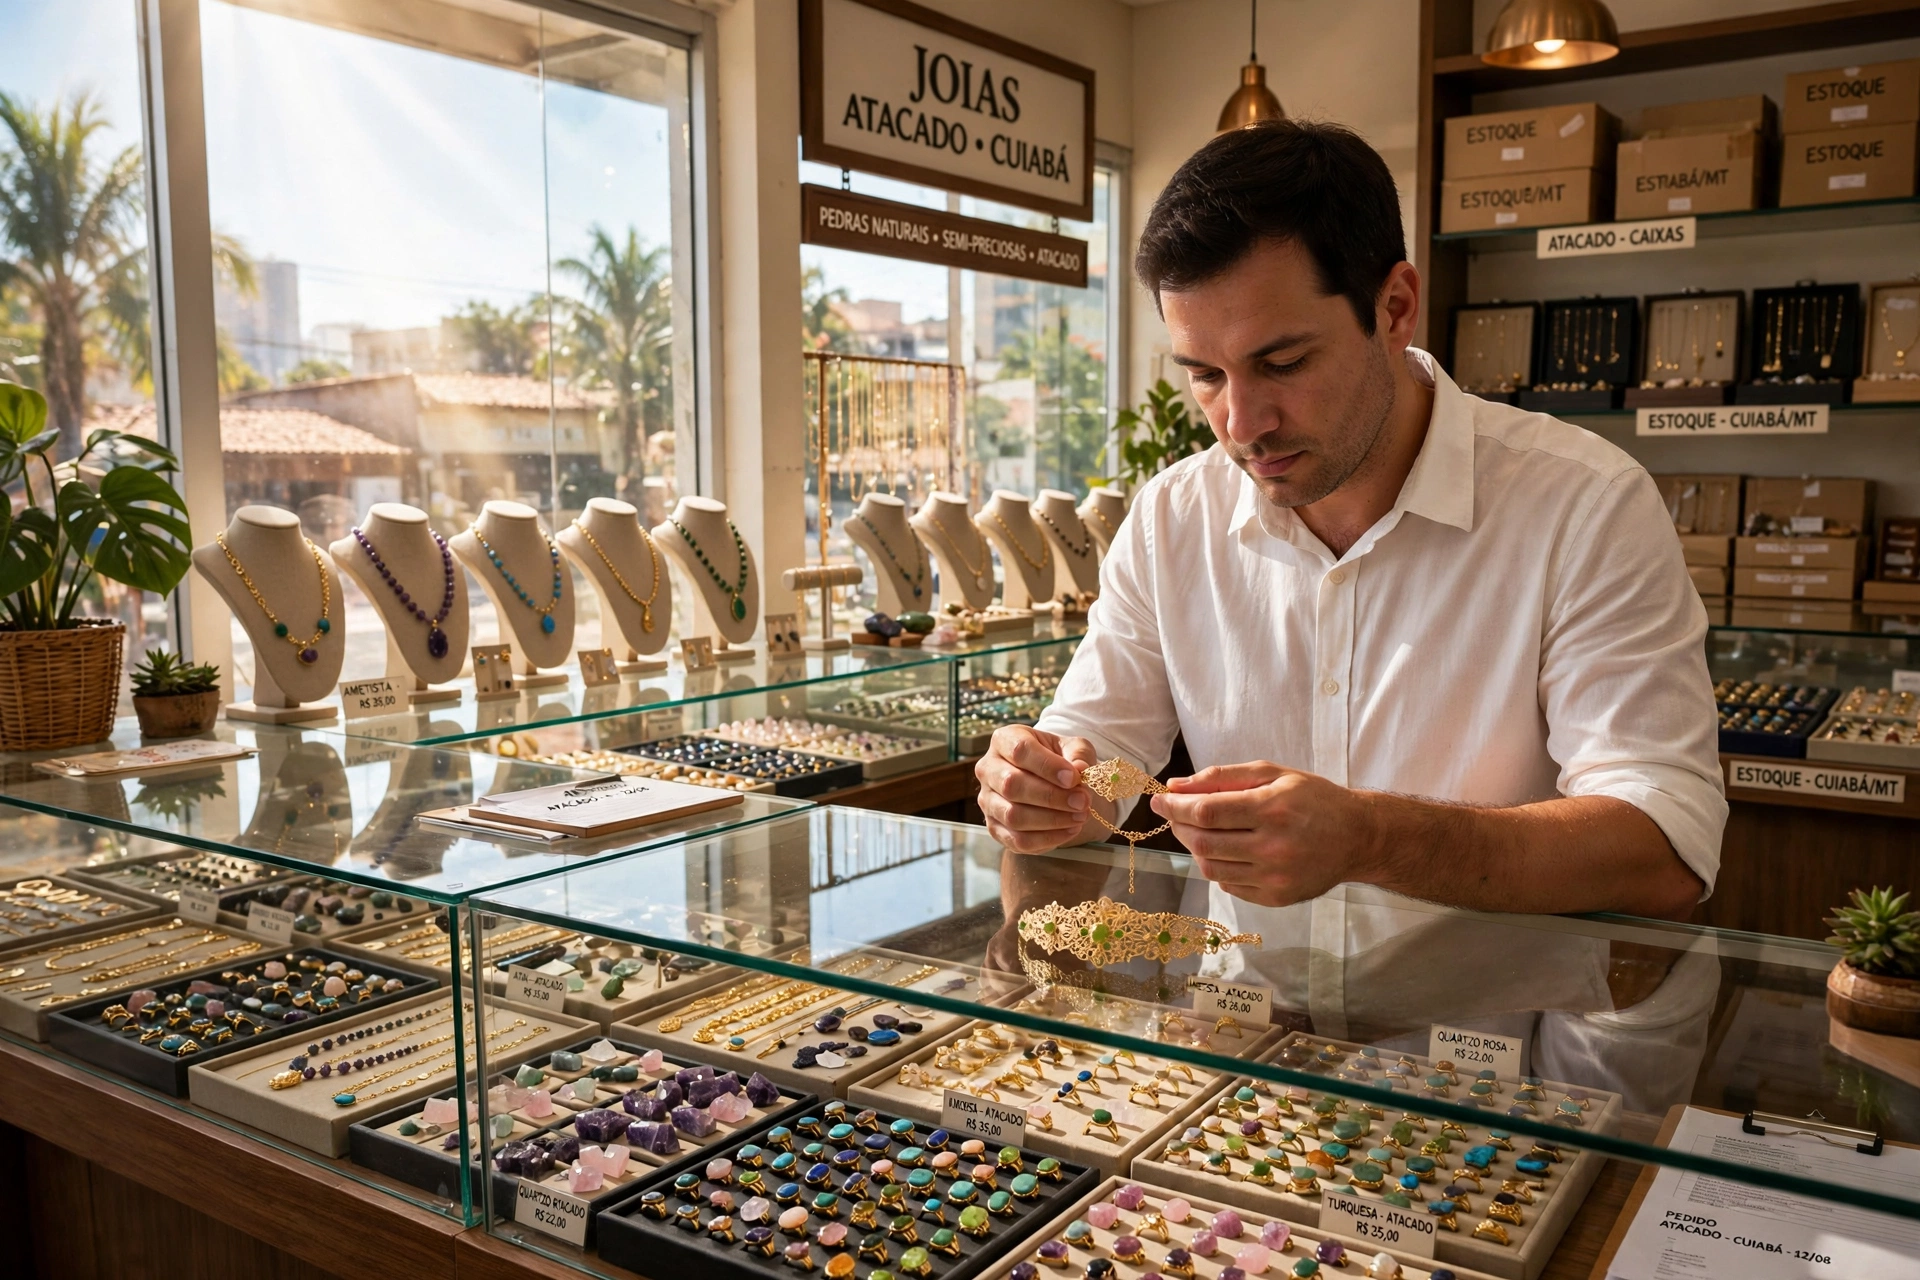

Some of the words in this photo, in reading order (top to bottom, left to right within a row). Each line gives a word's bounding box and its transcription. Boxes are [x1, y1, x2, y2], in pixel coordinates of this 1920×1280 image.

[909, 44, 1021, 123] JOIAS
[1805, 77, 1886, 102] ESTOQUE
[842, 93, 968, 155] ATACADO
[990, 134, 1070, 184] CUIABÁ
[1466, 120, 1537, 145] ESTOQUE
[1805, 140, 1884, 165] ESTOQUE
[1460, 183, 1566, 210] ESTOQUE/MT
[819, 206, 869, 234] PEDRAS
[872, 215, 929, 245] NATURAIS
[942, 229, 1026, 263] SEMI-PRECIOSAS
[1036, 250, 1080, 272] ATACADO
[1548, 231, 1616, 251] ATACADO
[1630, 226, 1684, 245] CAIXAS
[1648, 411, 1716, 431] ESTOQUE
[1730, 407, 1817, 428] CUIABÁ/MT
[344, 681, 393, 697] AMETISTA
[1737, 766, 1802, 788] ESTOQUE
[1814, 773, 1899, 797] CUIABÁ/MT
[1438, 1031, 1480, 1047] QUARTZO
[1483, 1039, 1507, 1053] ROSA
[1455, 1048, 1466, 1059] R$
[1468, 1050, 1494, 1063] 22,00
[966, 1118, 977, 1130] R$
[979, 1121, 1001, 1136] 35,00
[985, 1107, 1023, 1126] ATACADO
[545, 1211, 567, 1229] 22,00
[1328, 1197, 1377, 1219] TURQUESA
[1386, 1211, 1433, 1234] ATACADO
[1356, 1220, 1369, 1235] R$
[1665, 1210, 1717, 1227] PEDIDO
[1659, 1220, 1722, 1240] ATACADO
[1733, 1236, 1784, 1255] CUIABÁ
[1794, 1250, 1831, 1265] 12/08
